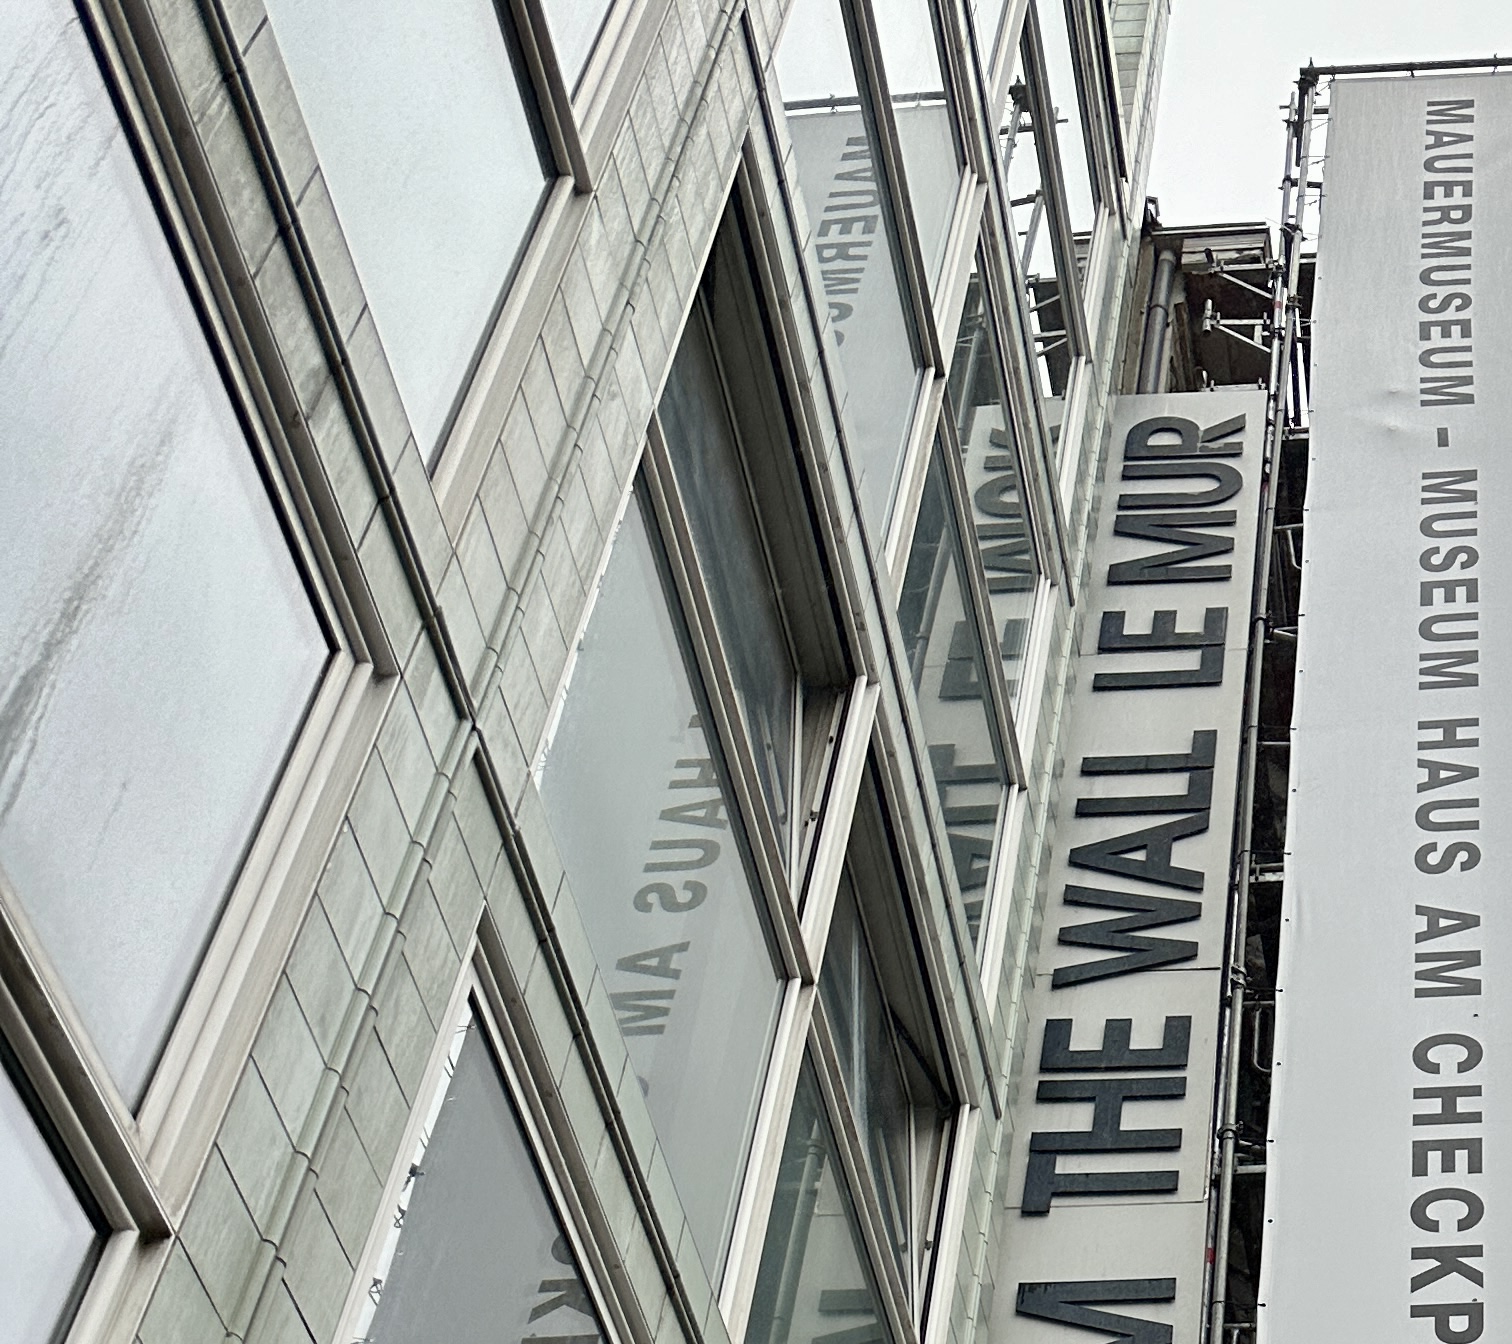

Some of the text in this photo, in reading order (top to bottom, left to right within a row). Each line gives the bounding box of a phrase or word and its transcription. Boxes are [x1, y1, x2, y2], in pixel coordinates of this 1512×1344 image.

[1418, 98, 1476, 407] MAUERMUSEUM
[1108, 413, 1247, 585] MUR
[1418, 469, 1480, 691] MUSEUM
[1093, 606, 1229, 691] LE
[1052, 729, 1218, 988] WALL
[1413, 717, 1482, 875] HAUS
[1413, 903, 1483, 999] AM
[1021, 1014, 1192, 1216] THE
